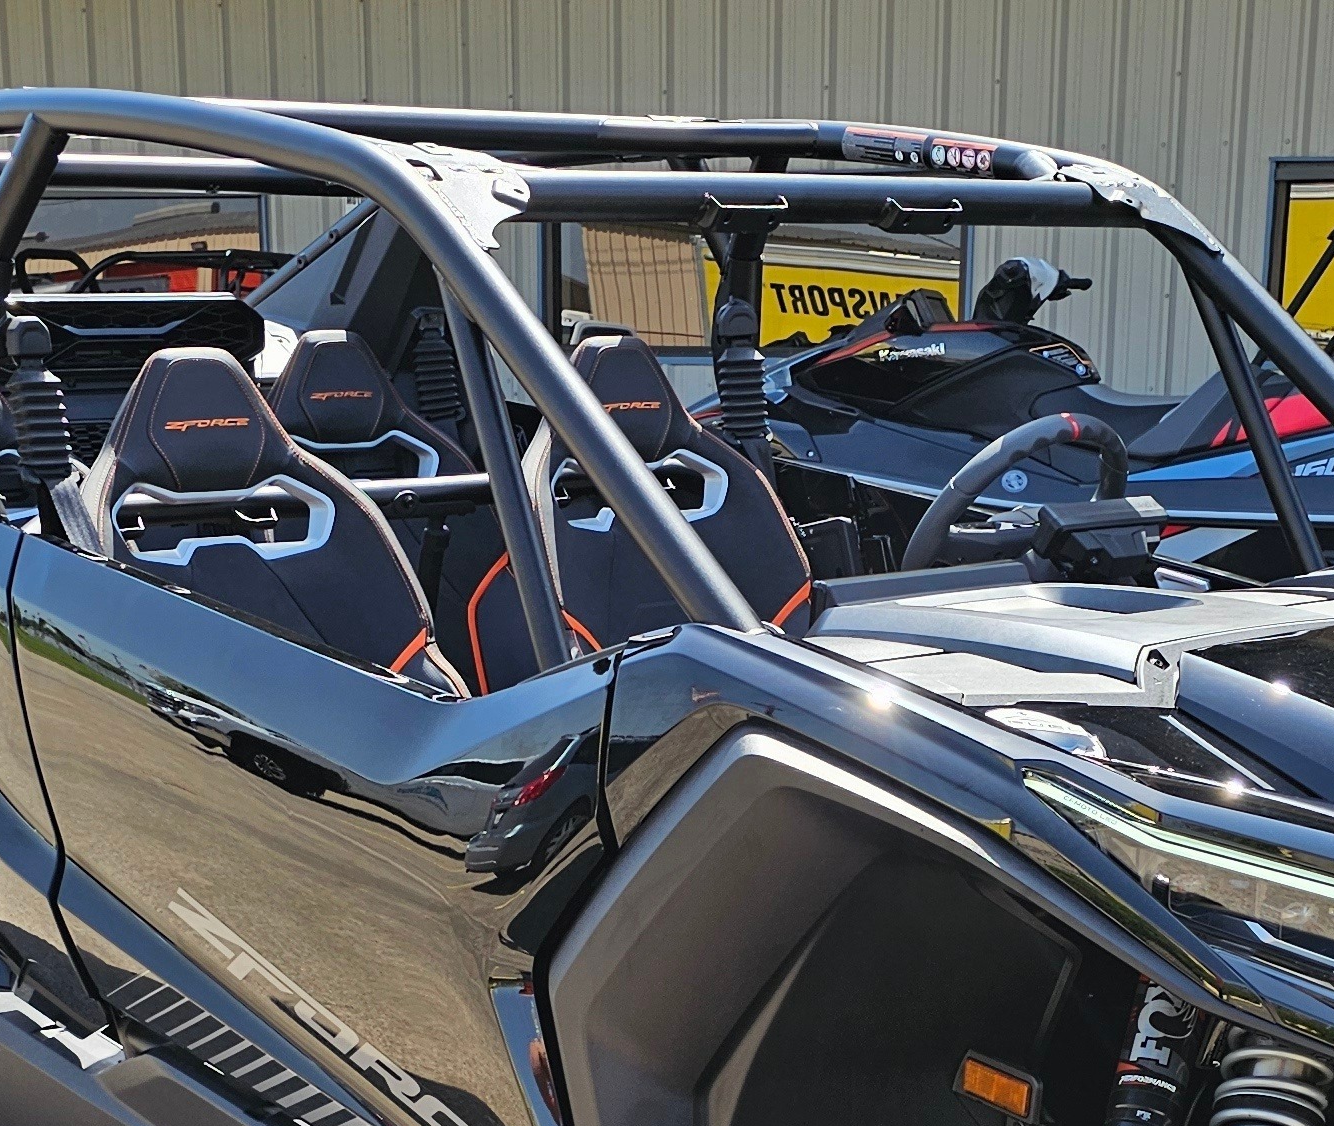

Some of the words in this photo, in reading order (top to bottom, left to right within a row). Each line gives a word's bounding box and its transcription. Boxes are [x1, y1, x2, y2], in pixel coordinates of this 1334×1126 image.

[310, 390, 373, 401] ZFORCE
[603, 401, 661, 413] FORCE
[164, 417, 250, 432] ZFORCE
[1063, 795, 1098, 816] CFMOTO
